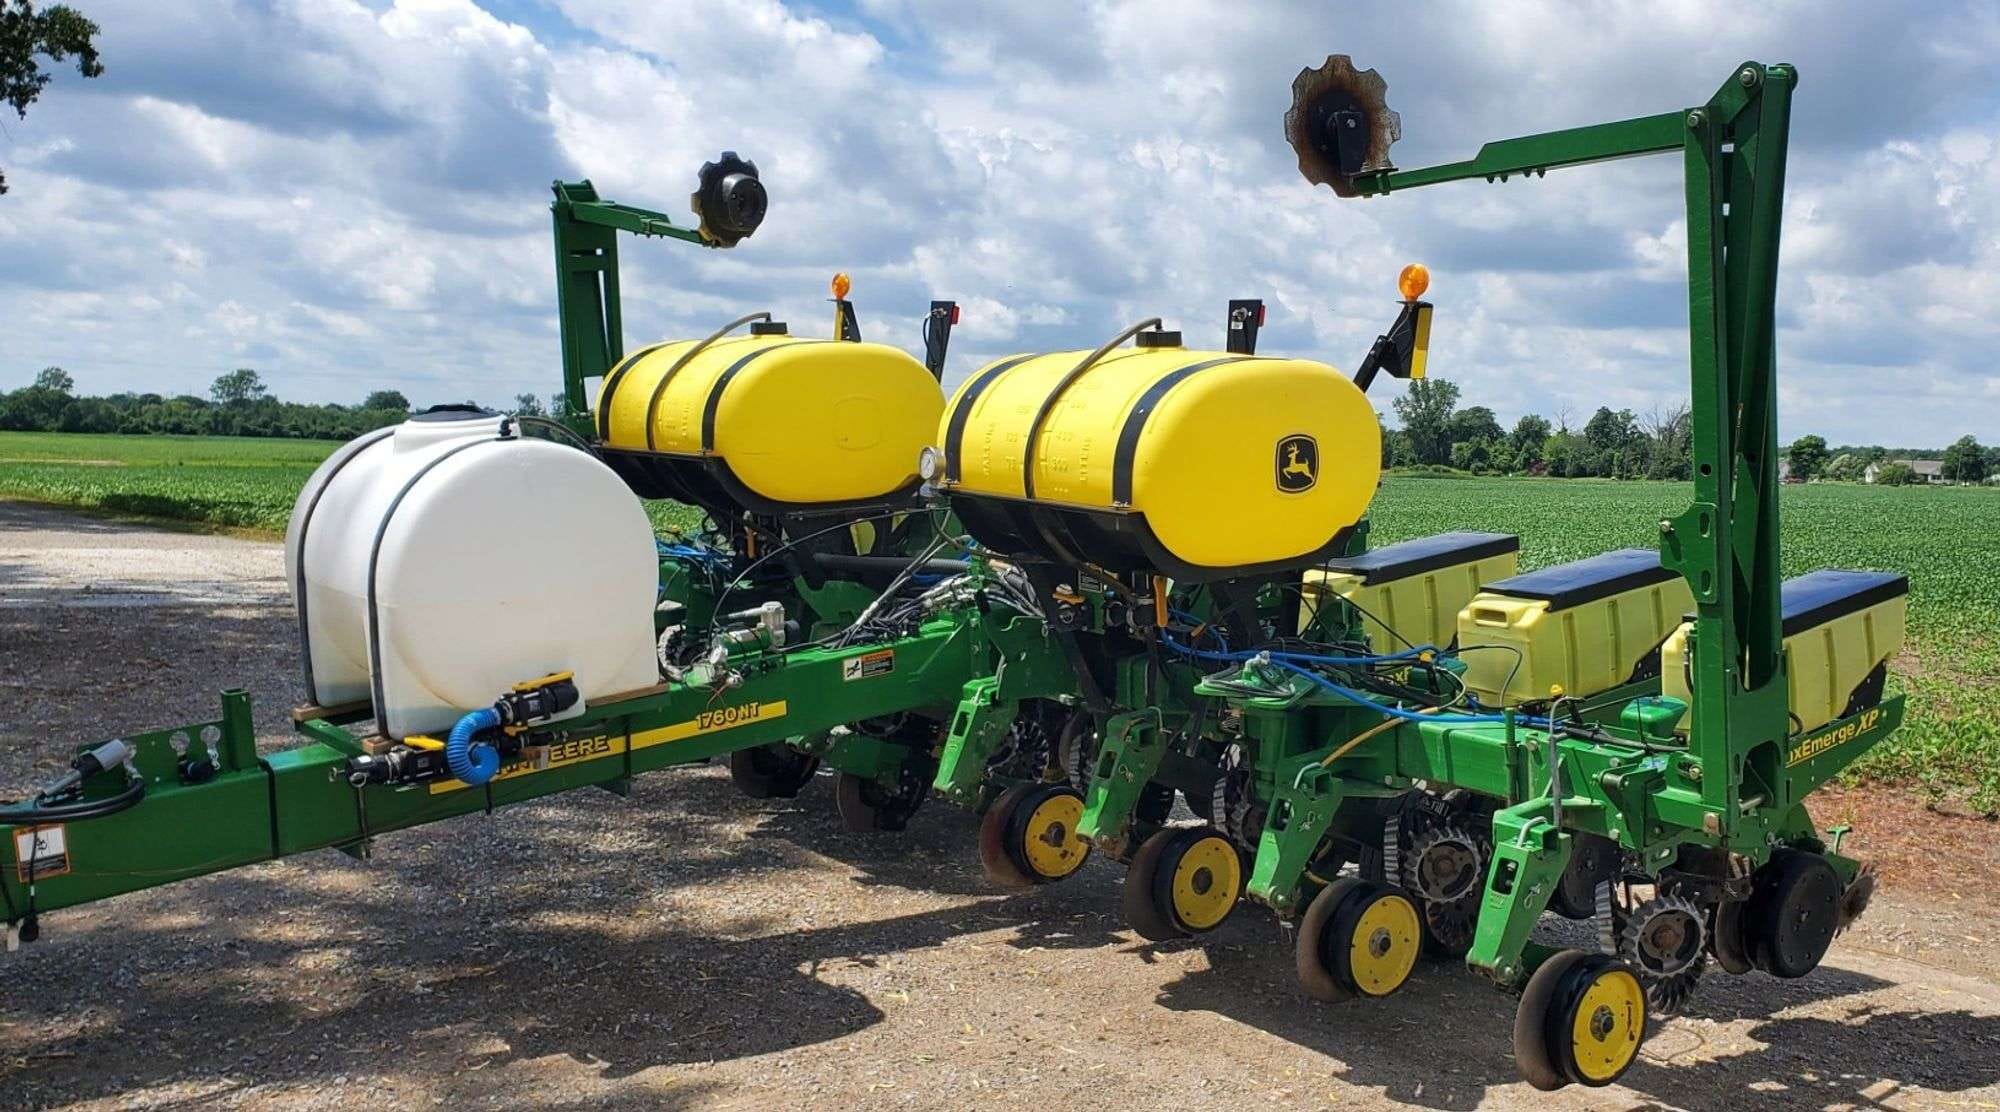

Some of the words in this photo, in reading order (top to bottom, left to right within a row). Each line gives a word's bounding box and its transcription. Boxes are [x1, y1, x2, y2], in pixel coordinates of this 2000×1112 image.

[695, 702, 759, 729] 1760NT
[535, 735, 608, 763] EERE
[1789, 722, 1856, 763] xEmerge
[1855, 709, 1879, 737] XP
